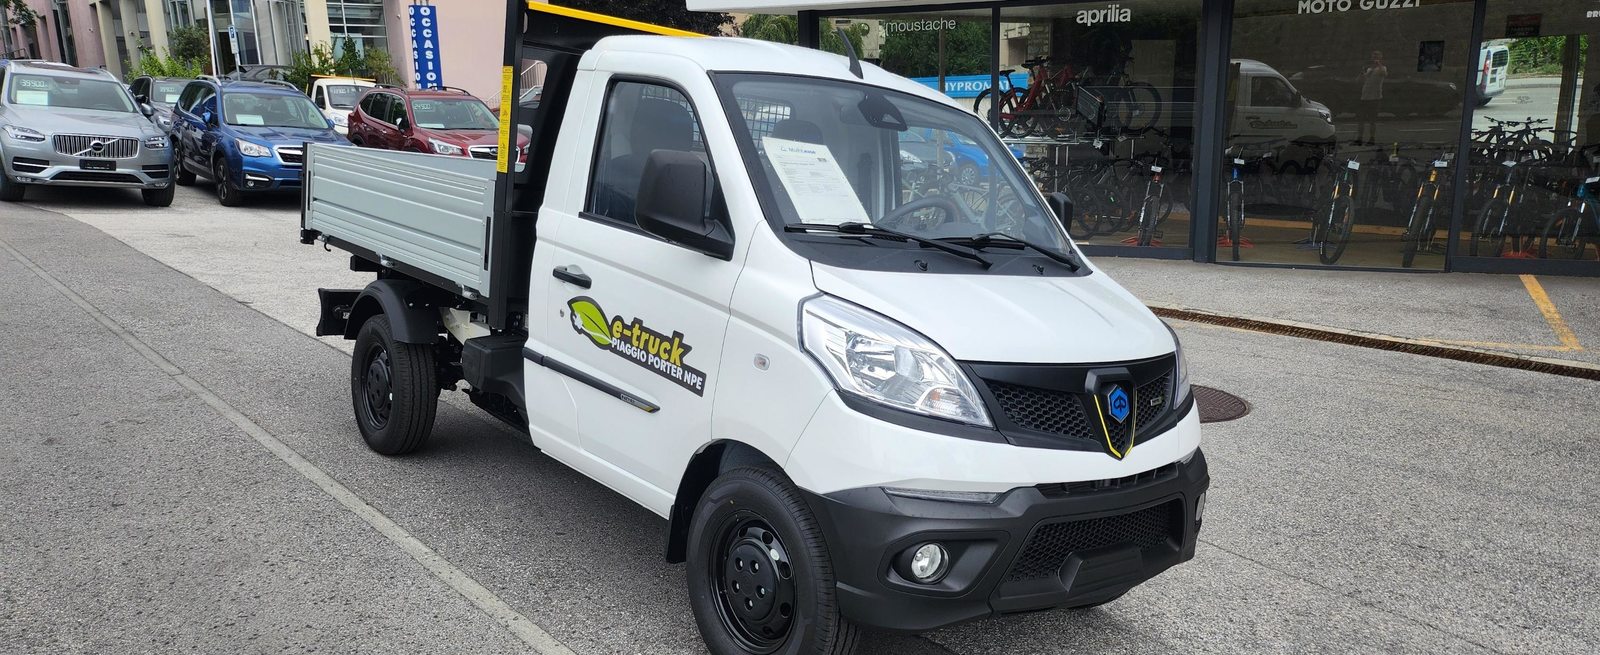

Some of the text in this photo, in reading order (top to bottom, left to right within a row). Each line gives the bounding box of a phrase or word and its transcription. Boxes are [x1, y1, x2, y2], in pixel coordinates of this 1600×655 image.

[1076, 4, 1132, 27] aprilia
[1298, 0, 1420, 15] MOTO GUZZI
[885, 17, 957, 37] moustache
[944, 79, 1010, 92] YPROMAT
[612, 320, 685, 366] e-truck
[611, 338, 703, 390] PIAGGIO PORTER NPE
